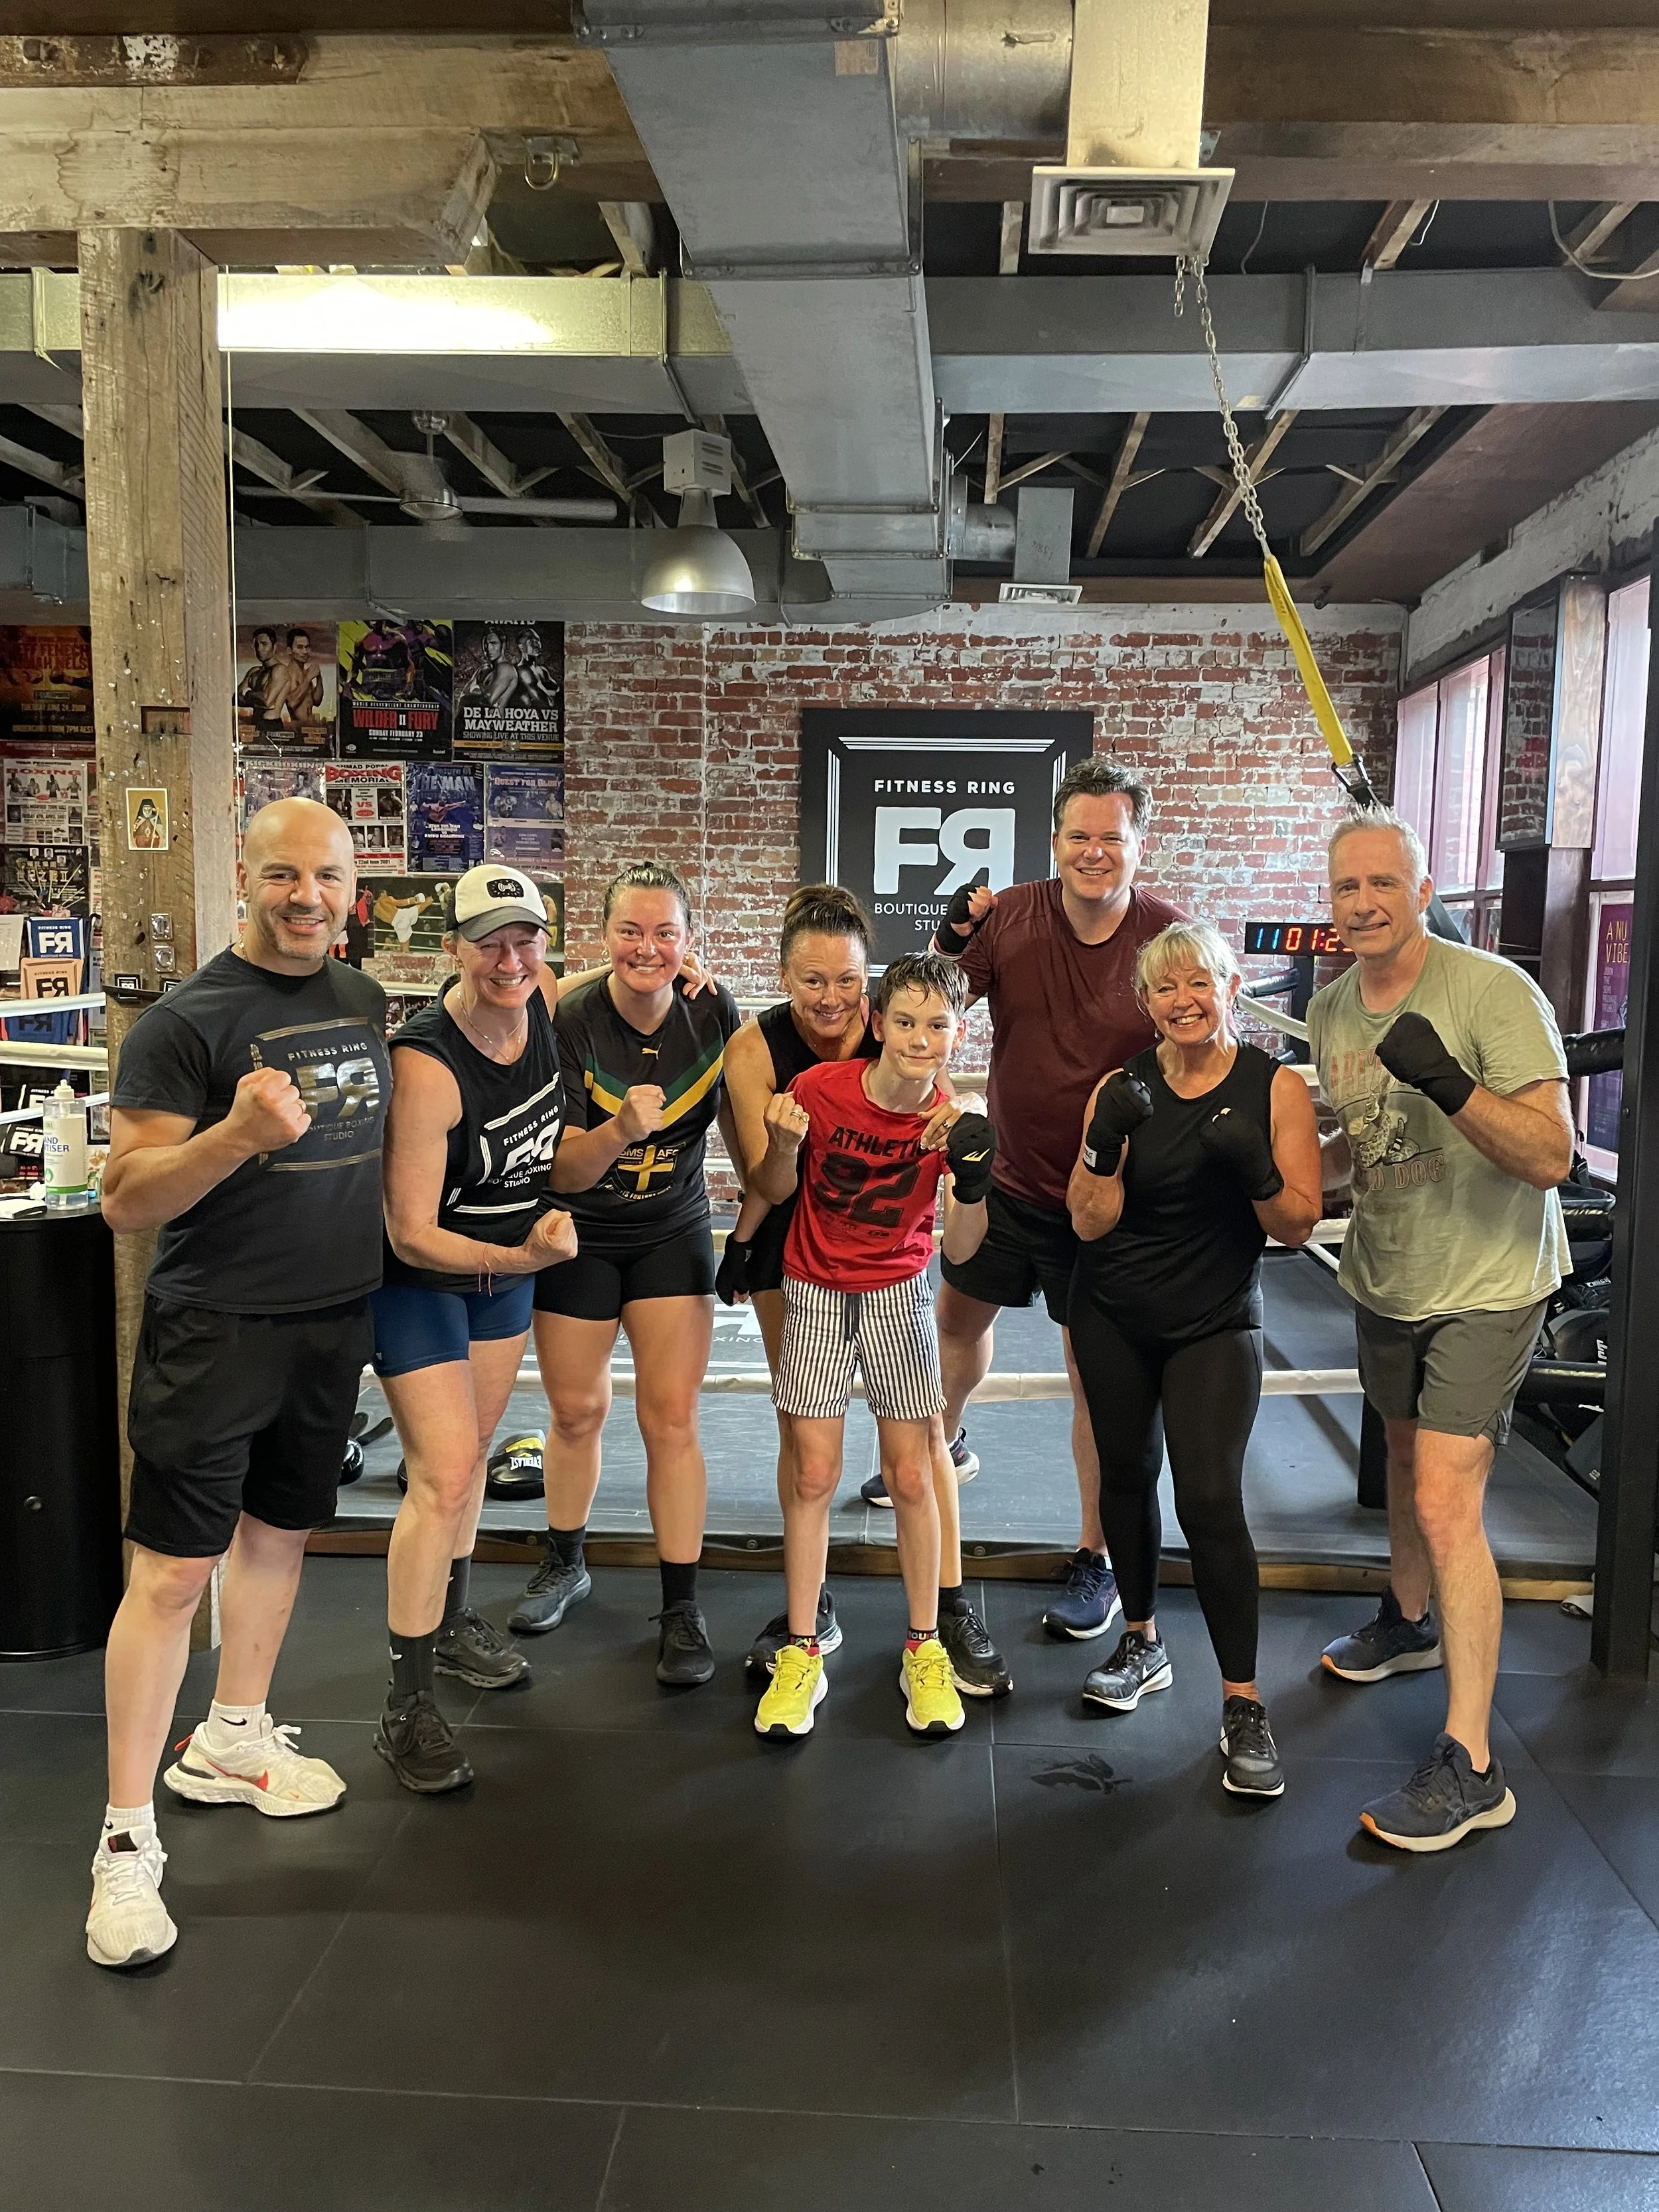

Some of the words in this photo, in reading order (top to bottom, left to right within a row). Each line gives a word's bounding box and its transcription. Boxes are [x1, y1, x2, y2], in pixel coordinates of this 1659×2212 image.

[353, 709, 397, 729] WILDER
[408, 711, 438, 730] FURY
[463, 707, 482, 718] DE
[484, 707, 501, 719] LA
[504, 708, 539, 720] HOYA
[541, 709, 559, 721] VS
[465, 719, 558, 733] MAYWEATHER
[325, 765, 401, 782] BOXING
[442, 776, 476, 791] MAN
[874, 779, 957, 794] FITNESS
[967, 780, 1015, 794] RING
[875, 903, 948, 916] BOUTIQUE
[914, 920, 940, 932] STU
[1607, 921, 1613, 940] A
[1616, 921, 1627, 941] NU
[287, 1047, 337, 1062] FITNESS
[342, 1042, 368, 1053] RING
[346, 1116, 374, 1129] BOXING
[503, 1120, 538, 1146] FITNESS
[541, 1105, 559, 1123] RING
[324, 1130, 354, 1142] STUDIO
[1392, 1154, 1445, 1189] DOG
[813, 1152, 922, 1228] 92
[510, 1455, 543, 1471] EVERLAST
